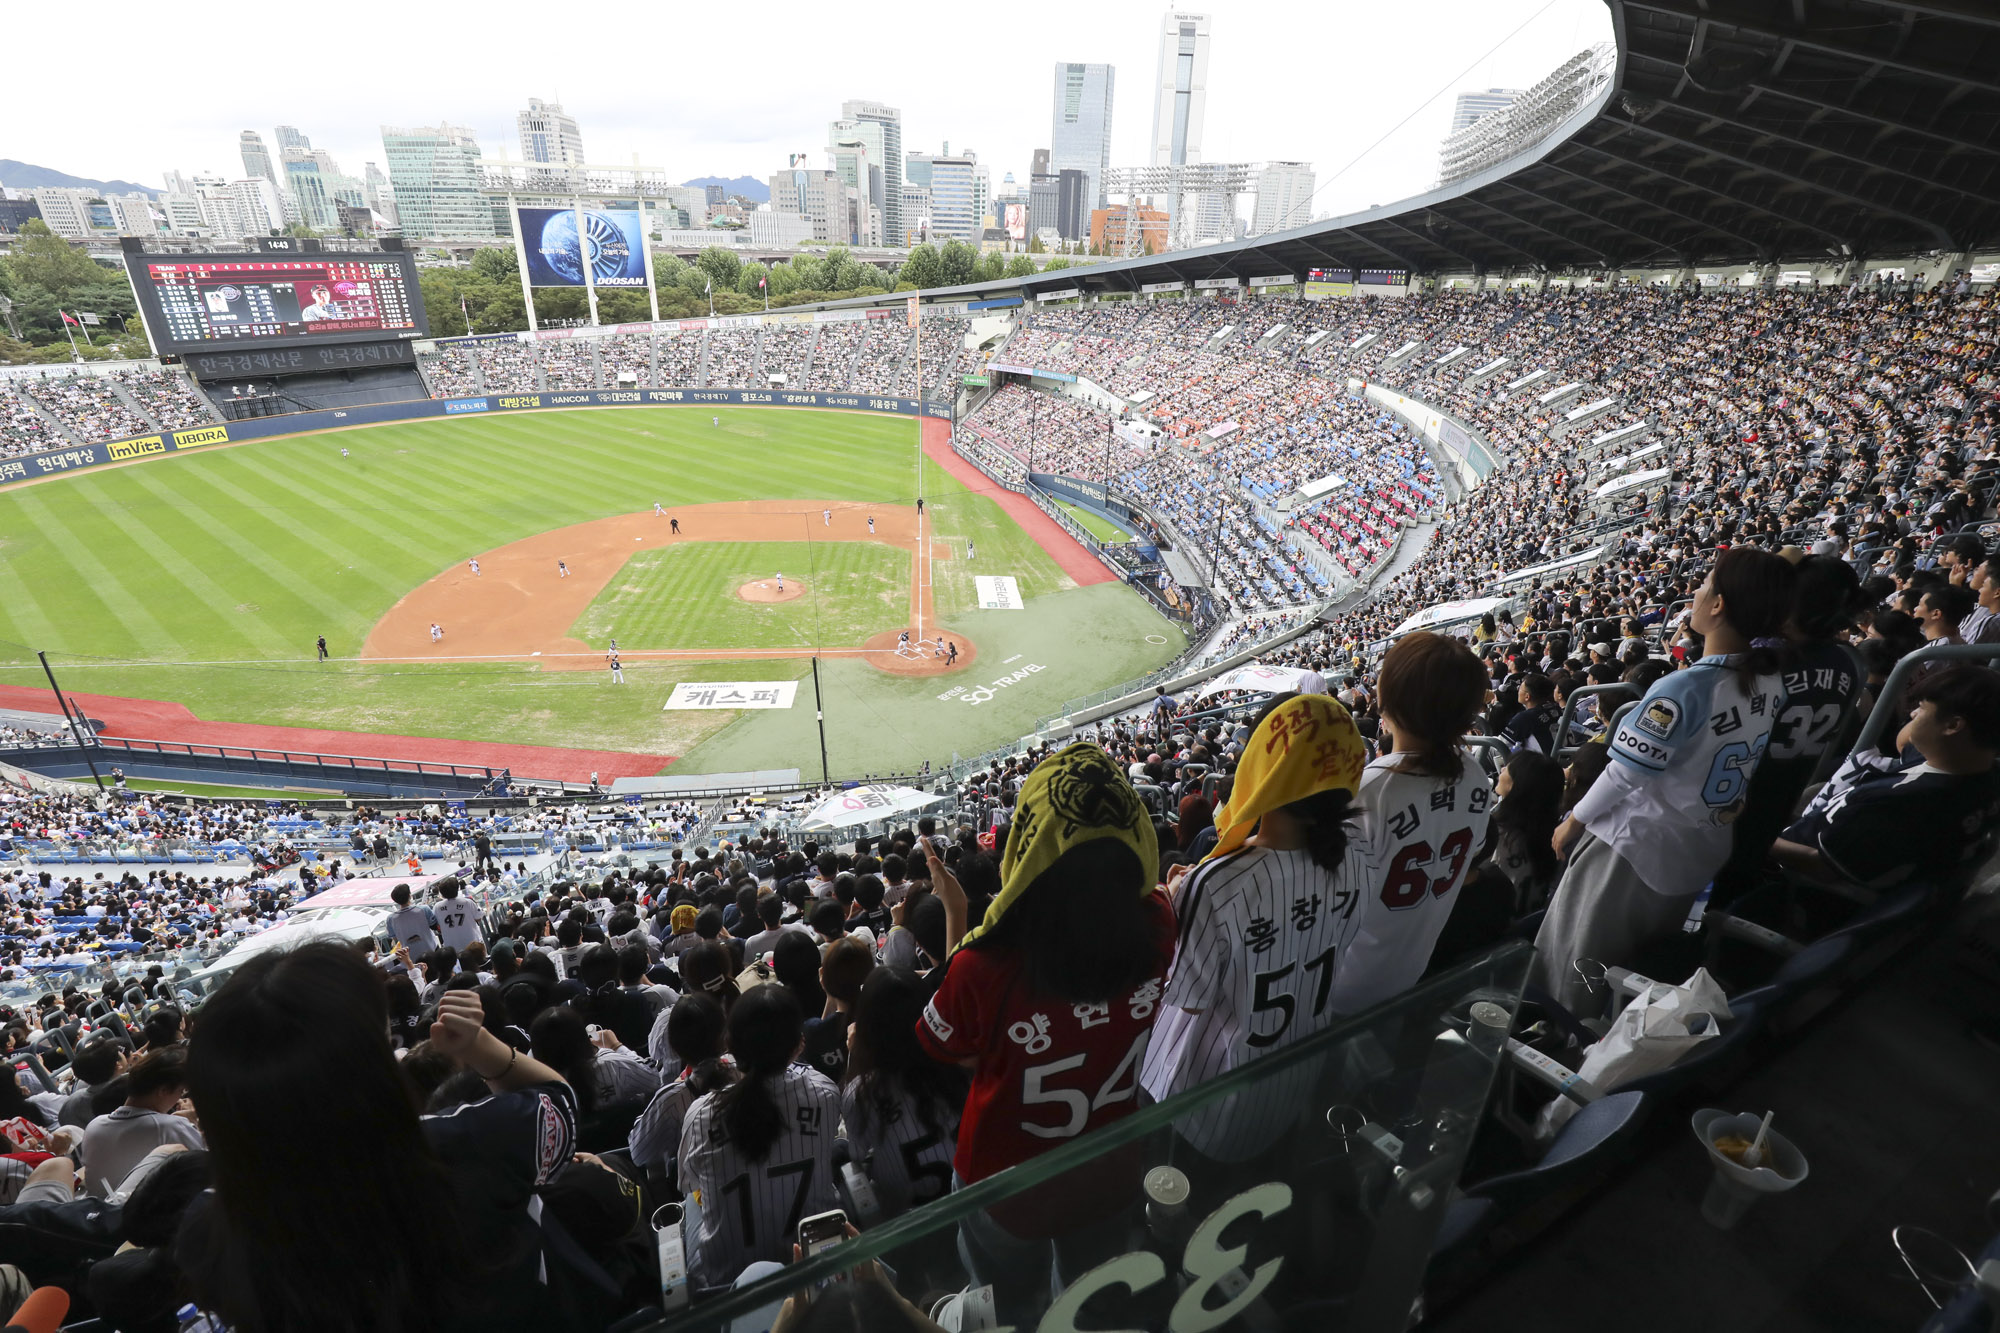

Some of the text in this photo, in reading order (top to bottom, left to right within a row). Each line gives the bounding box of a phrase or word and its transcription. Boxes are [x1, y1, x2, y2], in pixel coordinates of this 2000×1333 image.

[268, 240, 289, 250] 14:43
[198, 344, 404, 374] 한국경제신문 한국경제TV
[453, 402, 487, 412] 도미노피자
[498, 396, 540, 408] 대방건설
[552, 395, 589, 404] HANCOM
[612, 392, 641, 402] 대보건설
[870, 400, 898, 410] 키움증권
[175, 429, 227, 446] UBORA
[36, 449, 95, 473] 현대해상
[960, 664, 1047, 706] SOL TRAVEL
[1784, 668, 1852, 696] 김재환
[684, 688, 780, 706] 캐스퍼
[1769, 703, 1841, 759] 32
[1618, 731, 1668, 762] DOOTA
[1388, 786, 1488, 840] 김택연
[1380, 826, 1474, 912] 63
[444, 913, 465, 928] 47
[1245, 889, 1360, 954] 홍창기
[1245, 944, 1336, 1048] 57
[1008, 977, 1162, 1055] 양현종
[1020, 1027, 1151, 1138] 54
[720, 1157, 815, 1249] 17
